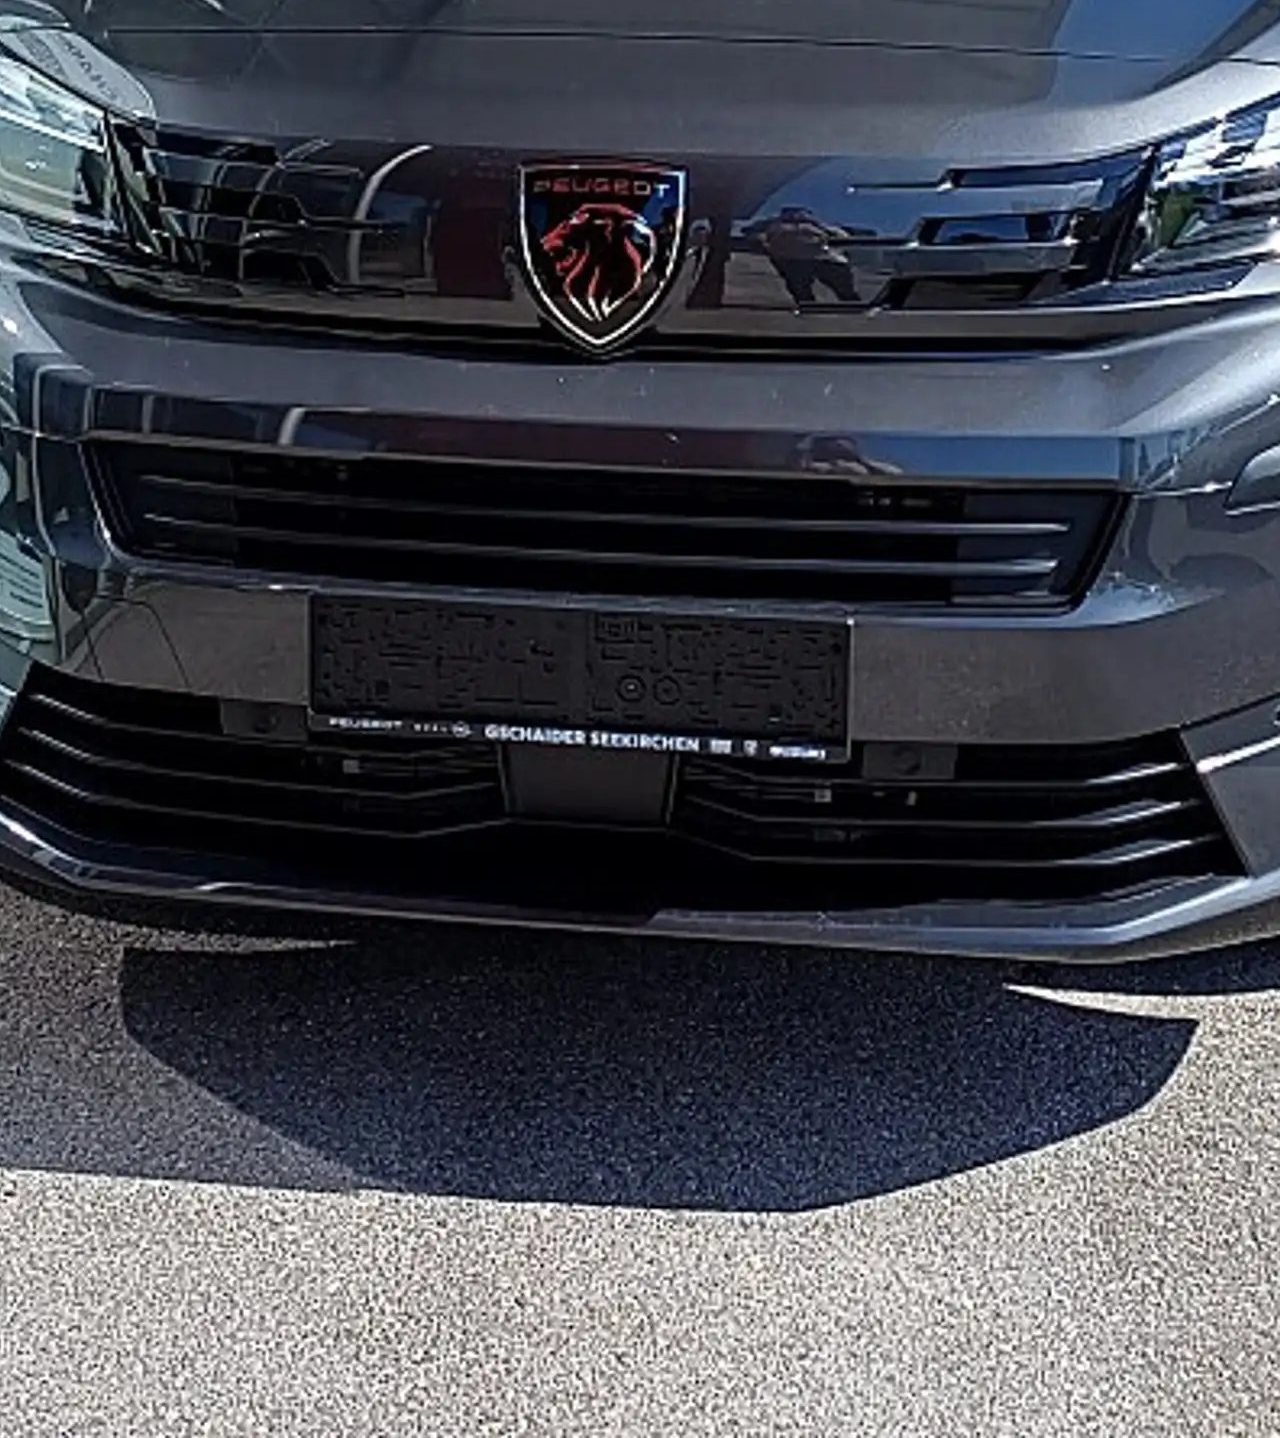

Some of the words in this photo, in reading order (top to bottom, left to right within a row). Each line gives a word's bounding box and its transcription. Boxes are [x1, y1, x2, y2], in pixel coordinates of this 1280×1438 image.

[532, 177, 671, 199] PEUGEOT
[485, 723, 586, 746] GSCHAIDER
[590, 729, 701, 753] SEEKIRCHEN
